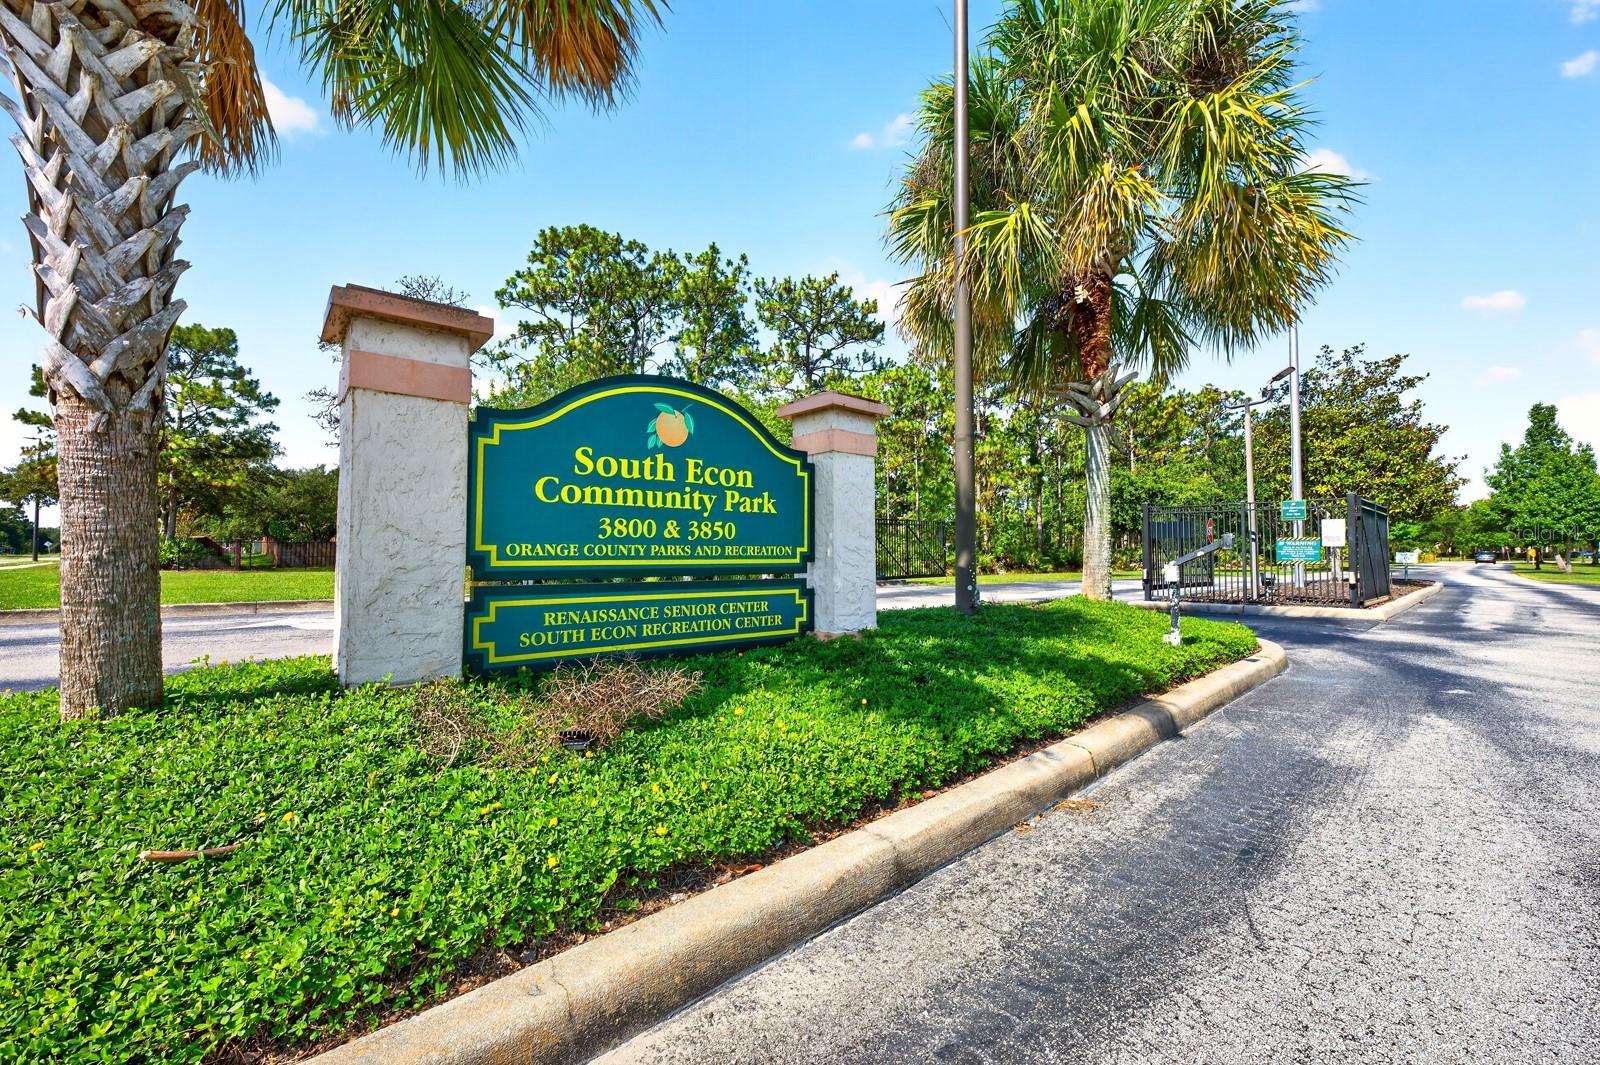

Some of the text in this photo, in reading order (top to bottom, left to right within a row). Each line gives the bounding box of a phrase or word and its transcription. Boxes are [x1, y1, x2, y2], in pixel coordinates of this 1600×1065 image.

[574, 446, 753, 488] South Econ
[534, 476, 778, 518] Community Park
[598, 517, 737, 541] 3800 & 3850
[505, 543, 793, 557] ORANGE COUNTY PARKS AND RECREATION
[543, 601, 769, 627] RENAISSANCE SENIOR CENTER
[519, 614, 783, 648] SOUTH ECON RECREATION CENTER
